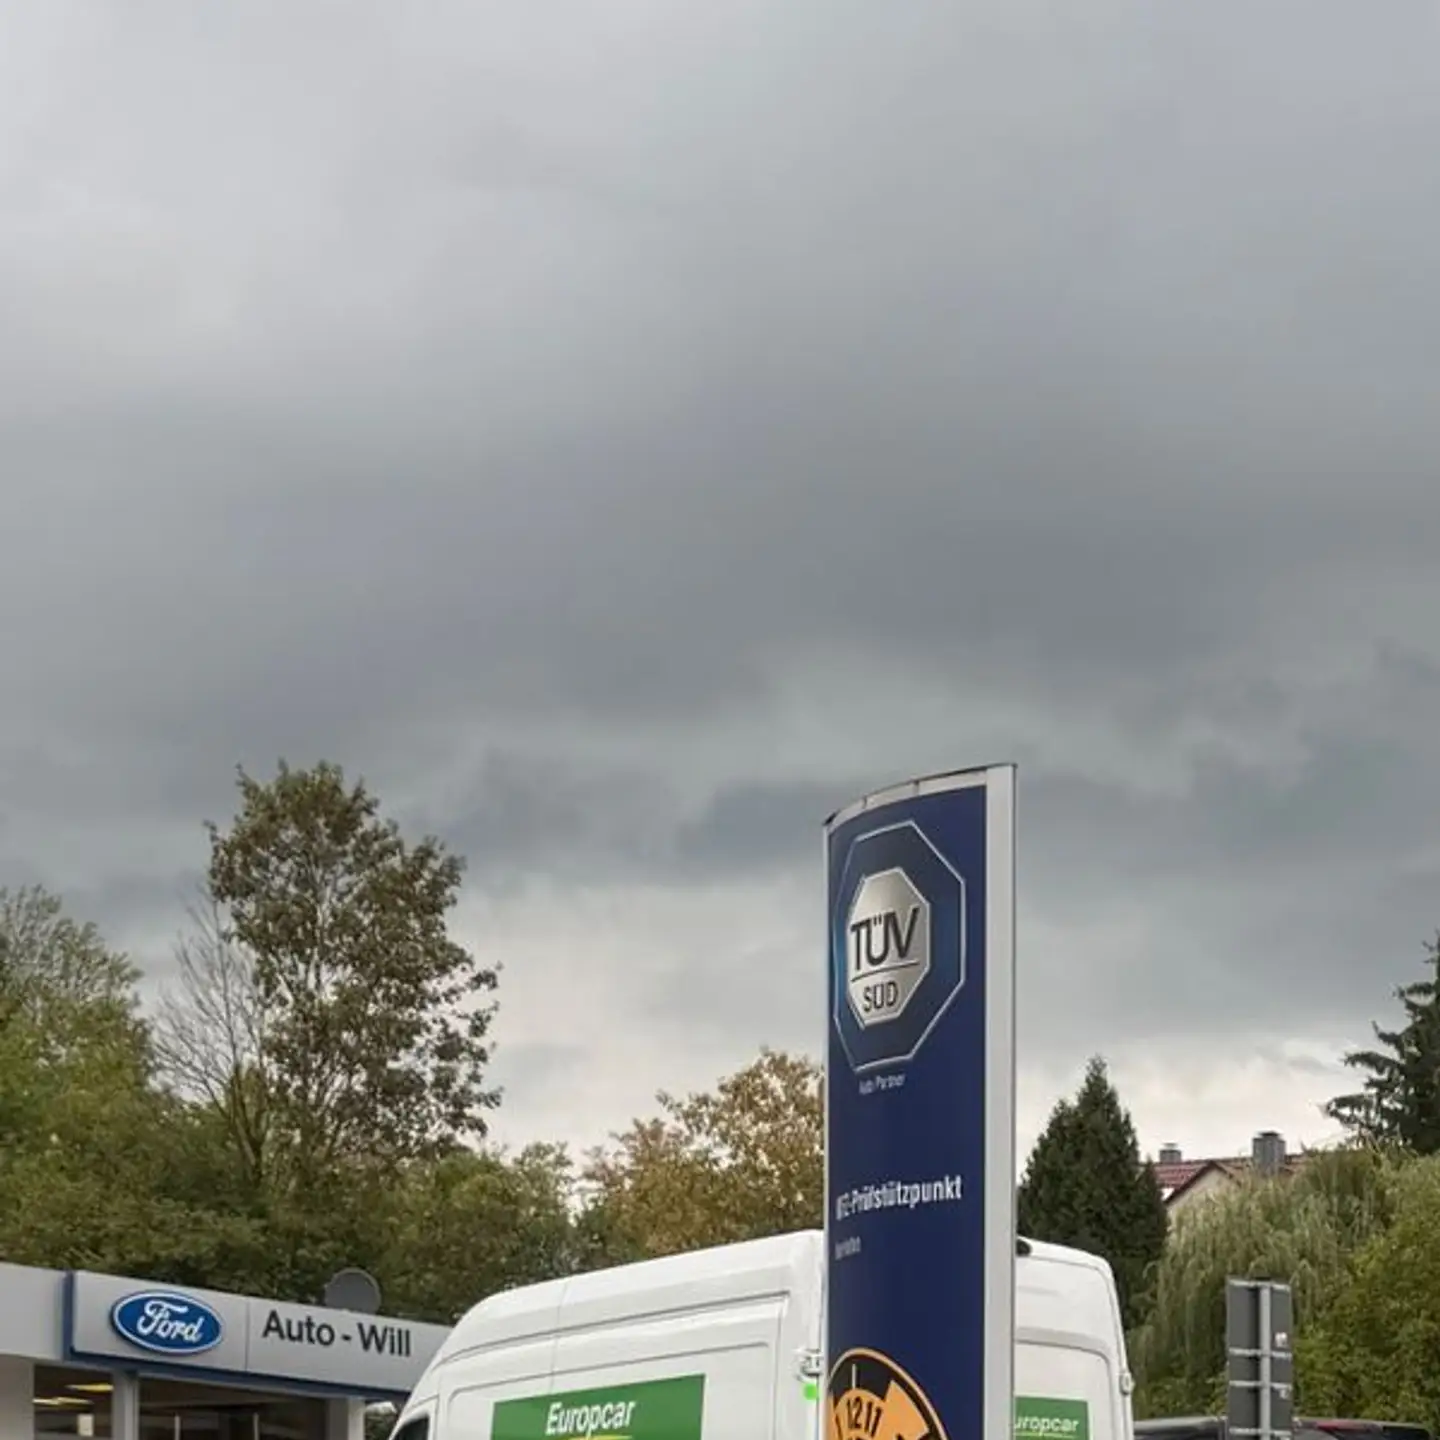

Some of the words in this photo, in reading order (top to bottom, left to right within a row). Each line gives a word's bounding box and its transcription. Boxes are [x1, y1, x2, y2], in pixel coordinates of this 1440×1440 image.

[850, 906, 920, 971] TÜV
[137, 1300, 204, 1344] Ford
[262, 1310, 335, 1346] Auto
[357, 1322, 411, 1357] Will
[846, 1396, 862, 1429] 12
[865, 1401, 884, 1438] 11
